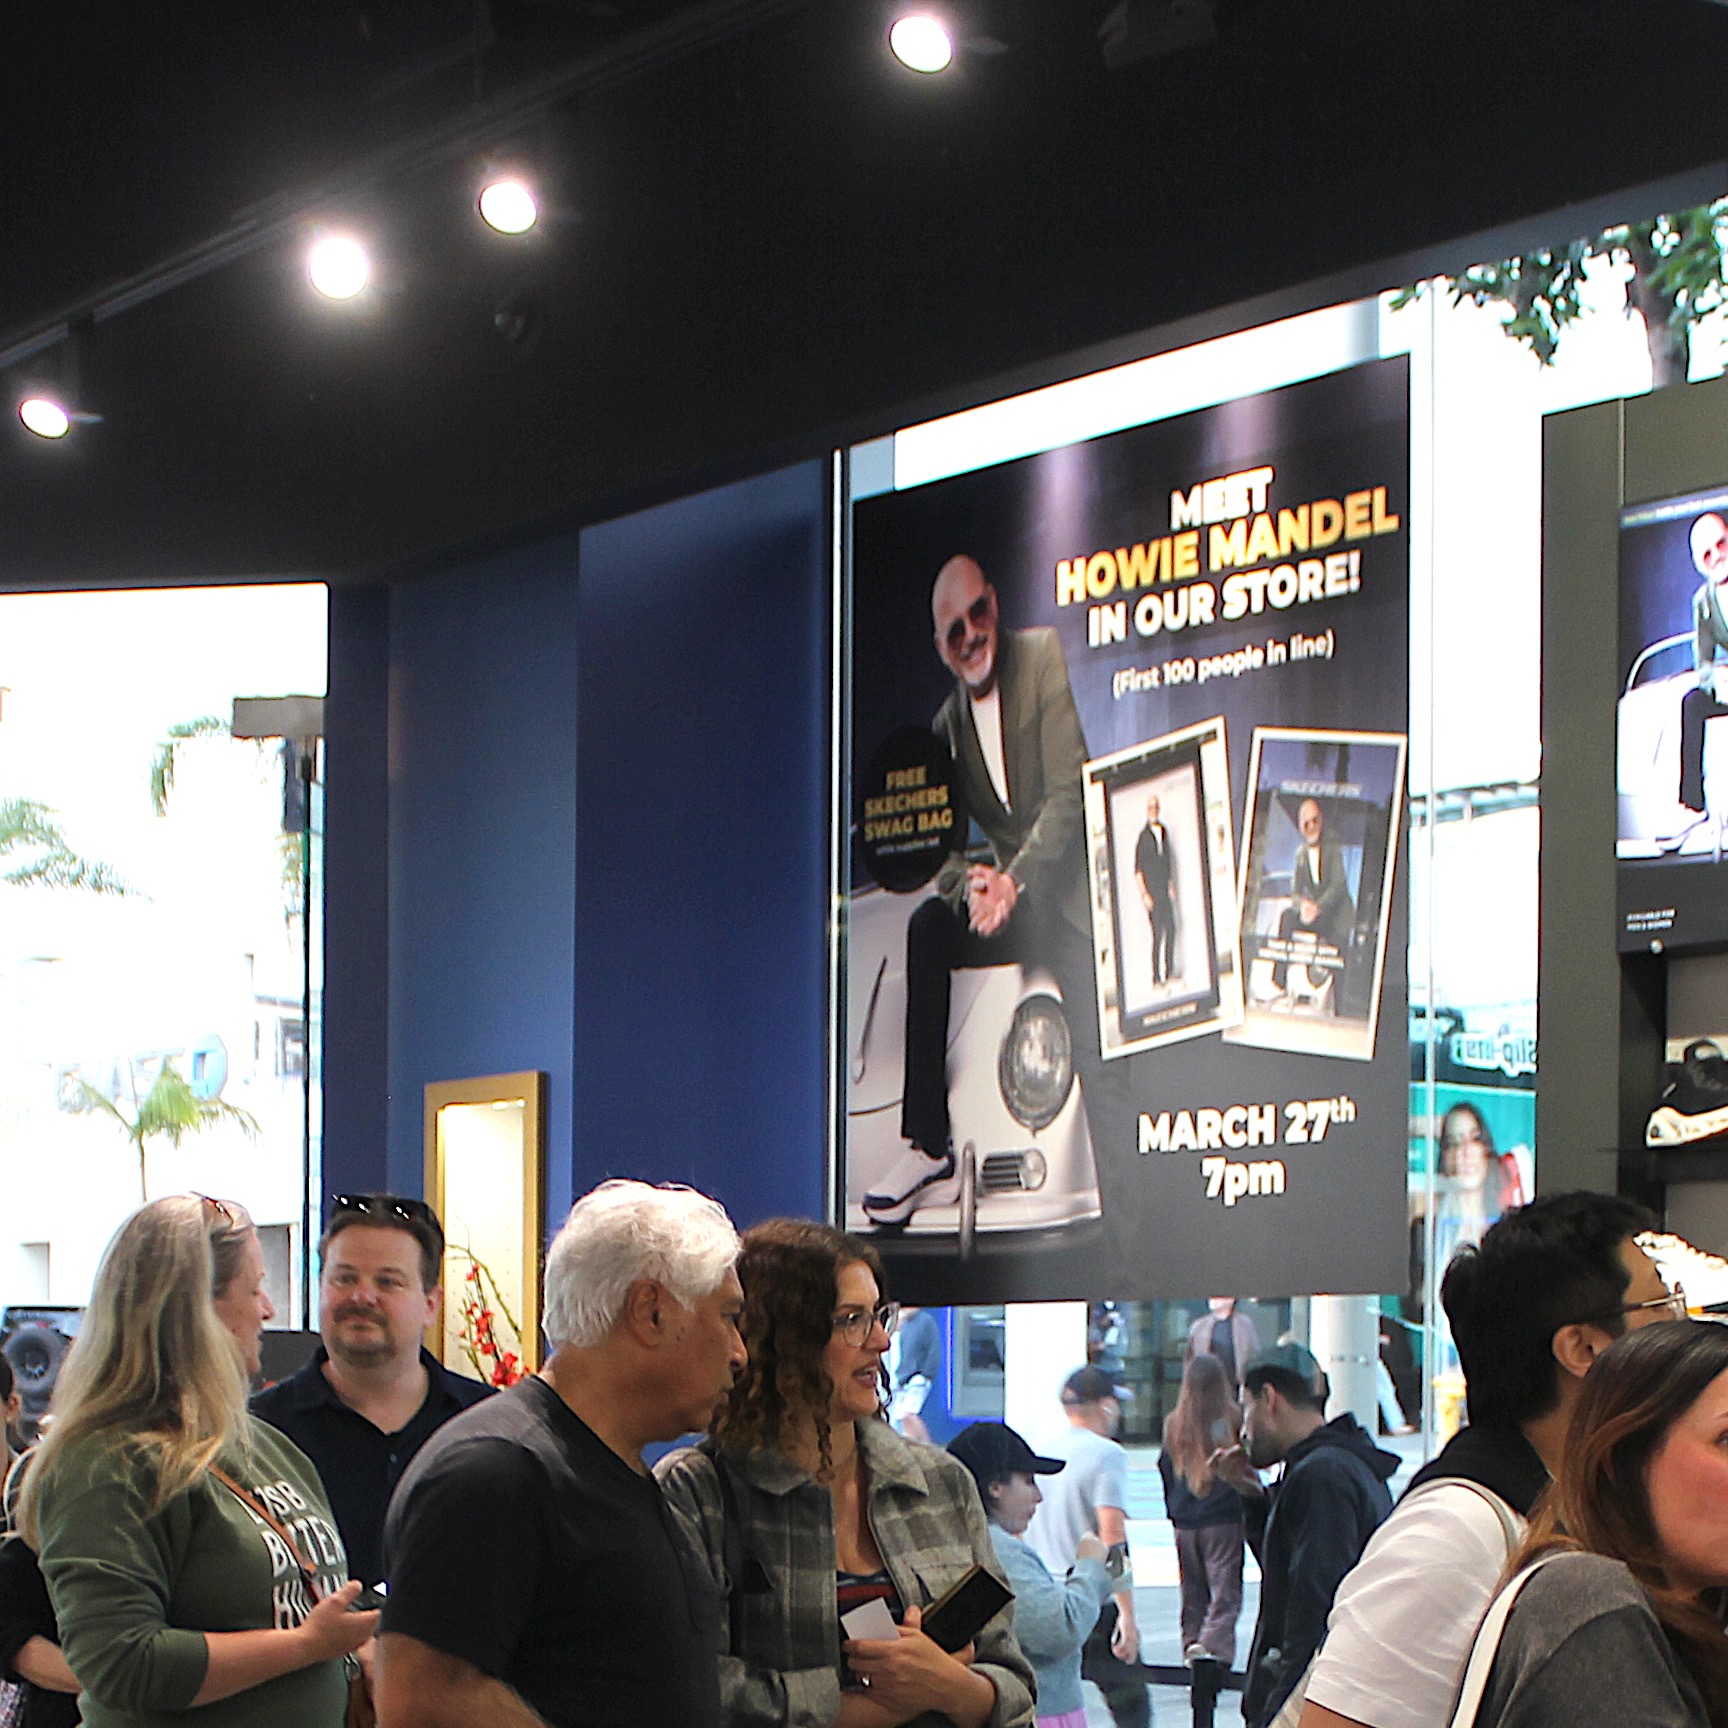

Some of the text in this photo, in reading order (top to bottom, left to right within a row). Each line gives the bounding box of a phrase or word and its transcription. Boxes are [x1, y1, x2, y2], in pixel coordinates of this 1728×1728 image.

[1170, 467, 1273, 530] MEET
[1056, 486, 1399, 607] HOWIE MANDEL
[1088, 549, 1361, 648] IN OUR STORE!
[1112, 628, 1334, 699] (First 100 people in line)
[865, 814, 914, 842] SWAG
[1138, 1096, 1356, 1155] MARCH 27th
[1201, 1155, 1286, 1206] 7pm
